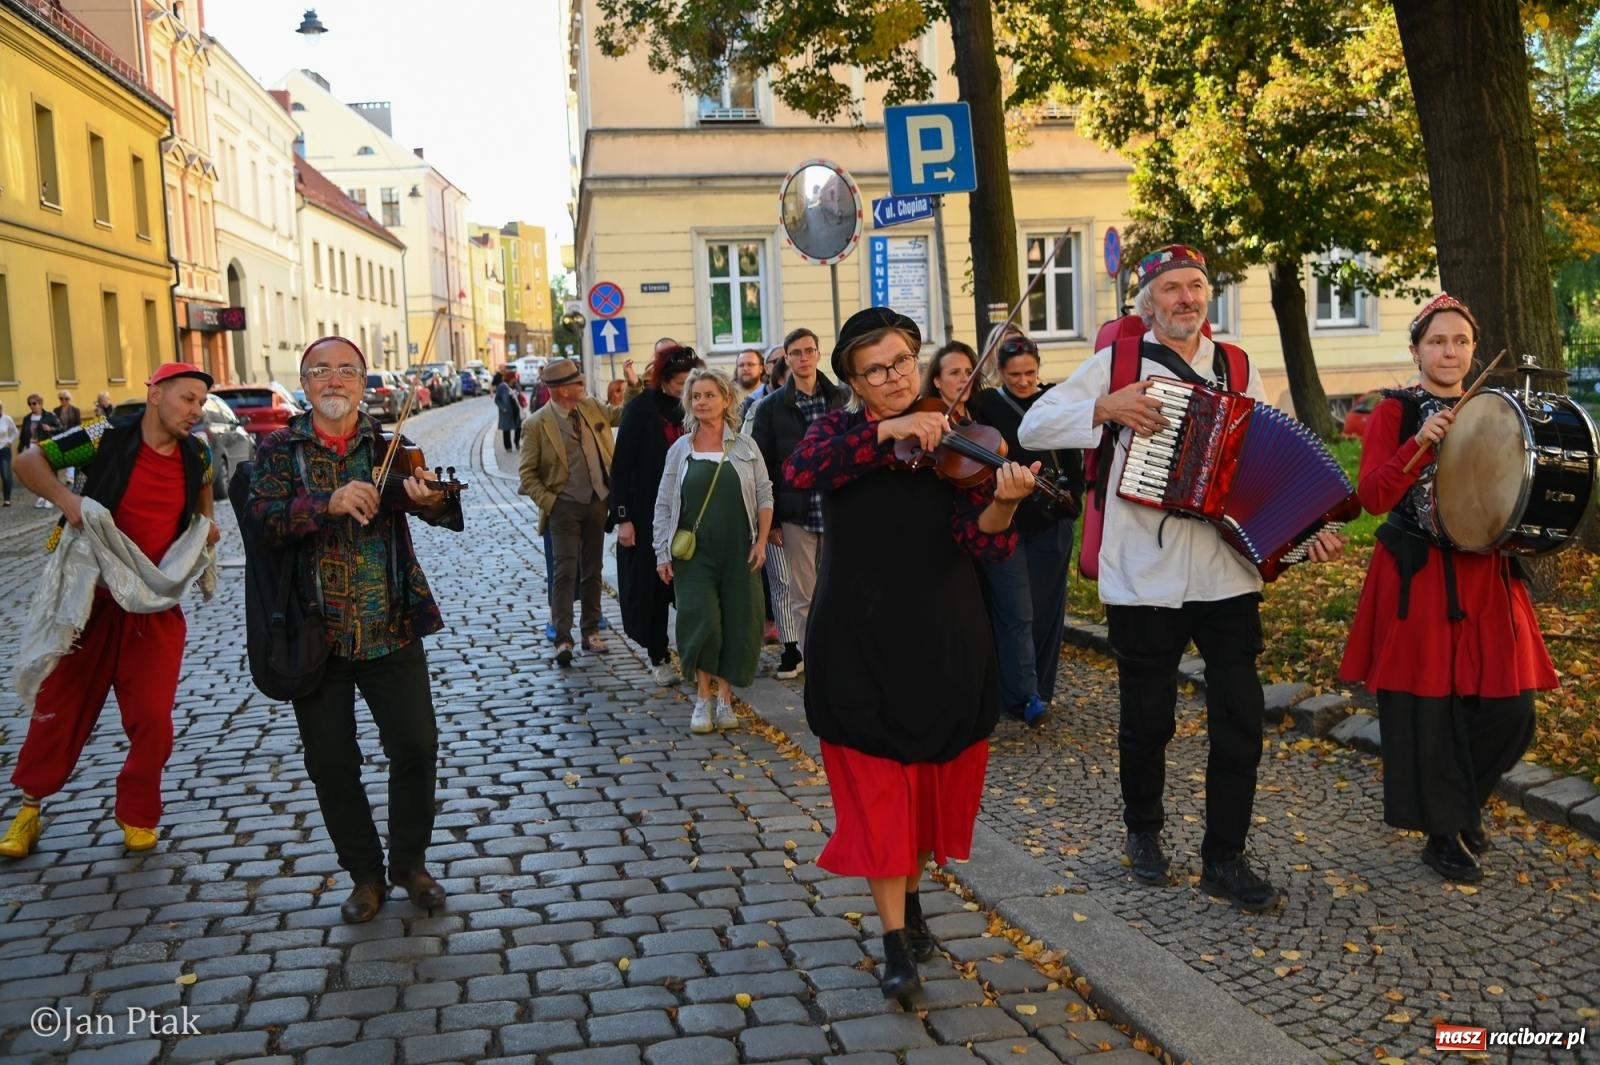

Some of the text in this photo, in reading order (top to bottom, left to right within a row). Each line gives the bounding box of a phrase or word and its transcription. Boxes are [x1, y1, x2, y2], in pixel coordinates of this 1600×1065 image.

[906, 114, 955, 184] P
[885, 196, 928, 219] ul. Chopina
[875, 241, 884, 308] DENTY
